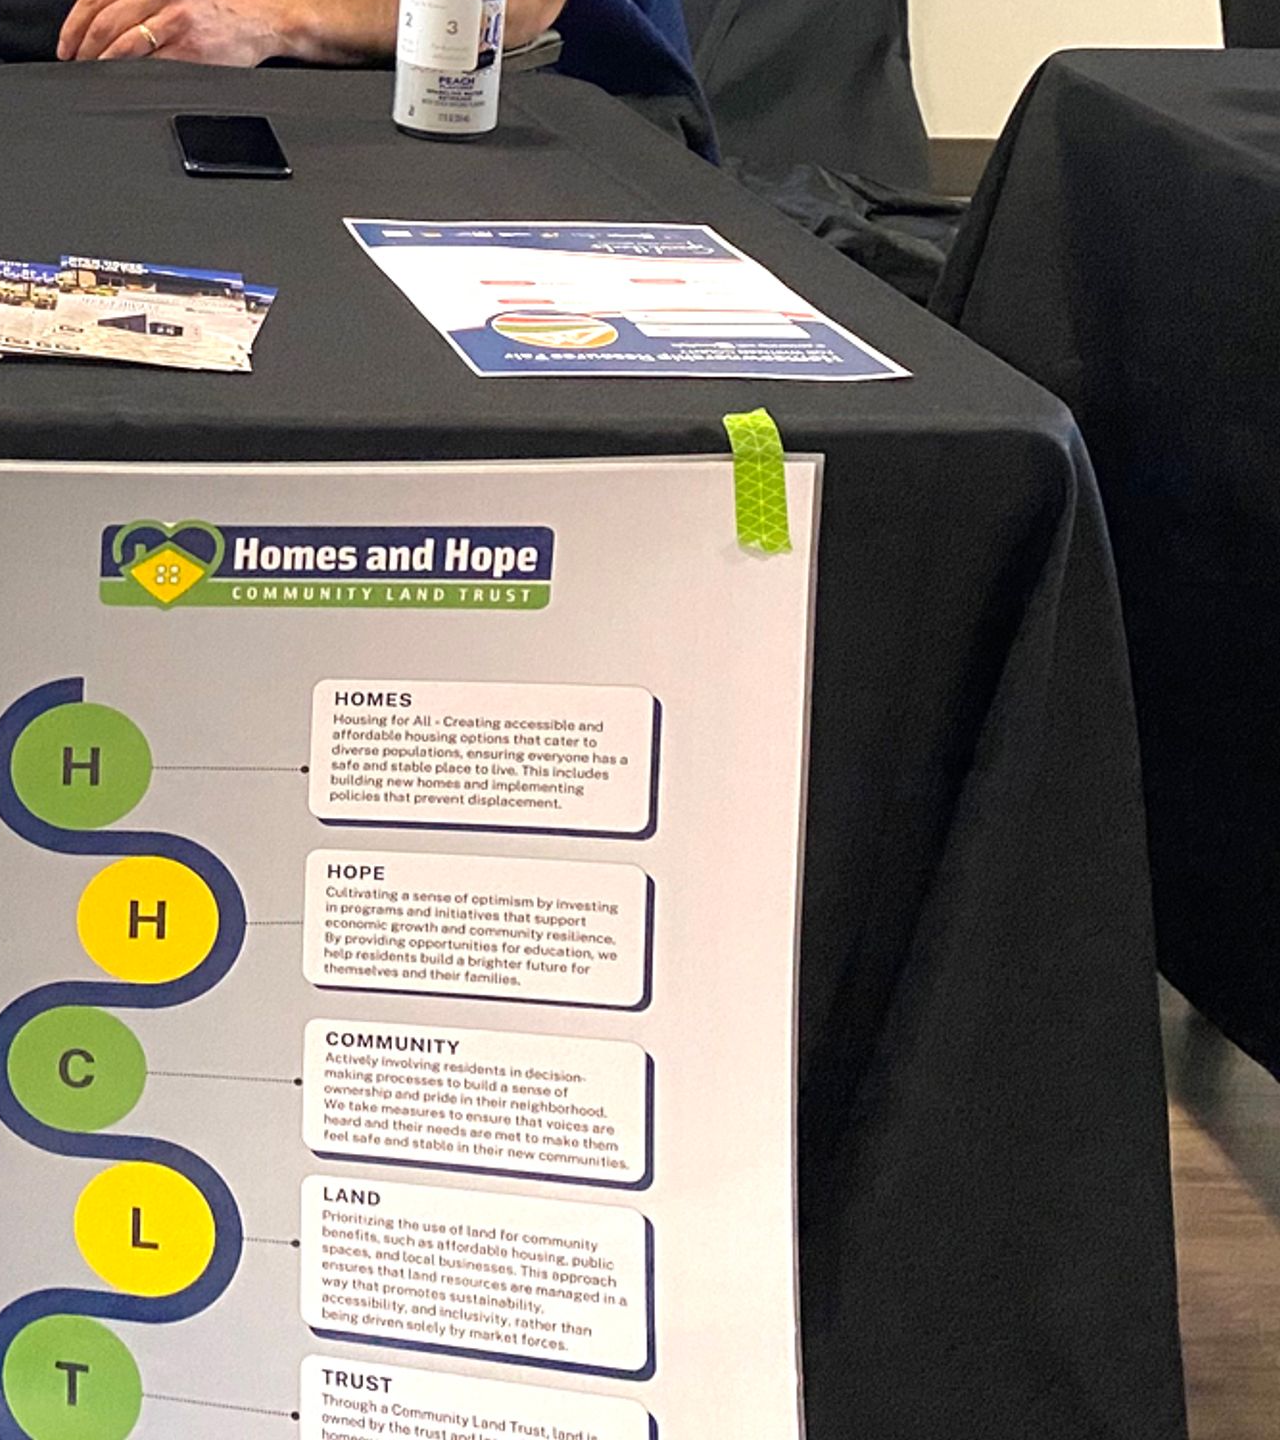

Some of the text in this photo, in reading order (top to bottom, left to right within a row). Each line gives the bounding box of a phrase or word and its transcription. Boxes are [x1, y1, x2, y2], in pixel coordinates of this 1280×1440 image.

[447, 20, 458, 35] 3
[439, 76, 475, 85] PEACH
[234, 538, 537, 577] Homes and Hope
[232, 586, 532, 603] COMMUNITY LAND TRUST
[335, 691, 412, 708] HOMES
[333, 715, 603, 732] Housing for All Creating accessible and
[62, 748, 100, 786] H
[330, 790, 562, 809] policies that prevent displacement.
[327, 865, 385, 881] HOPE
[129, 900, 167, 940] H
[326, 1031, 460, 1055] COMMUNITY
[58, 1048, 95, 1088] C
[324, 1187, 381, 1206] LAND
[131, 1208, 159, 1250] L
[56, 1362, 89, 1406] T
[322, 1369, 392, 1393] TRUST
